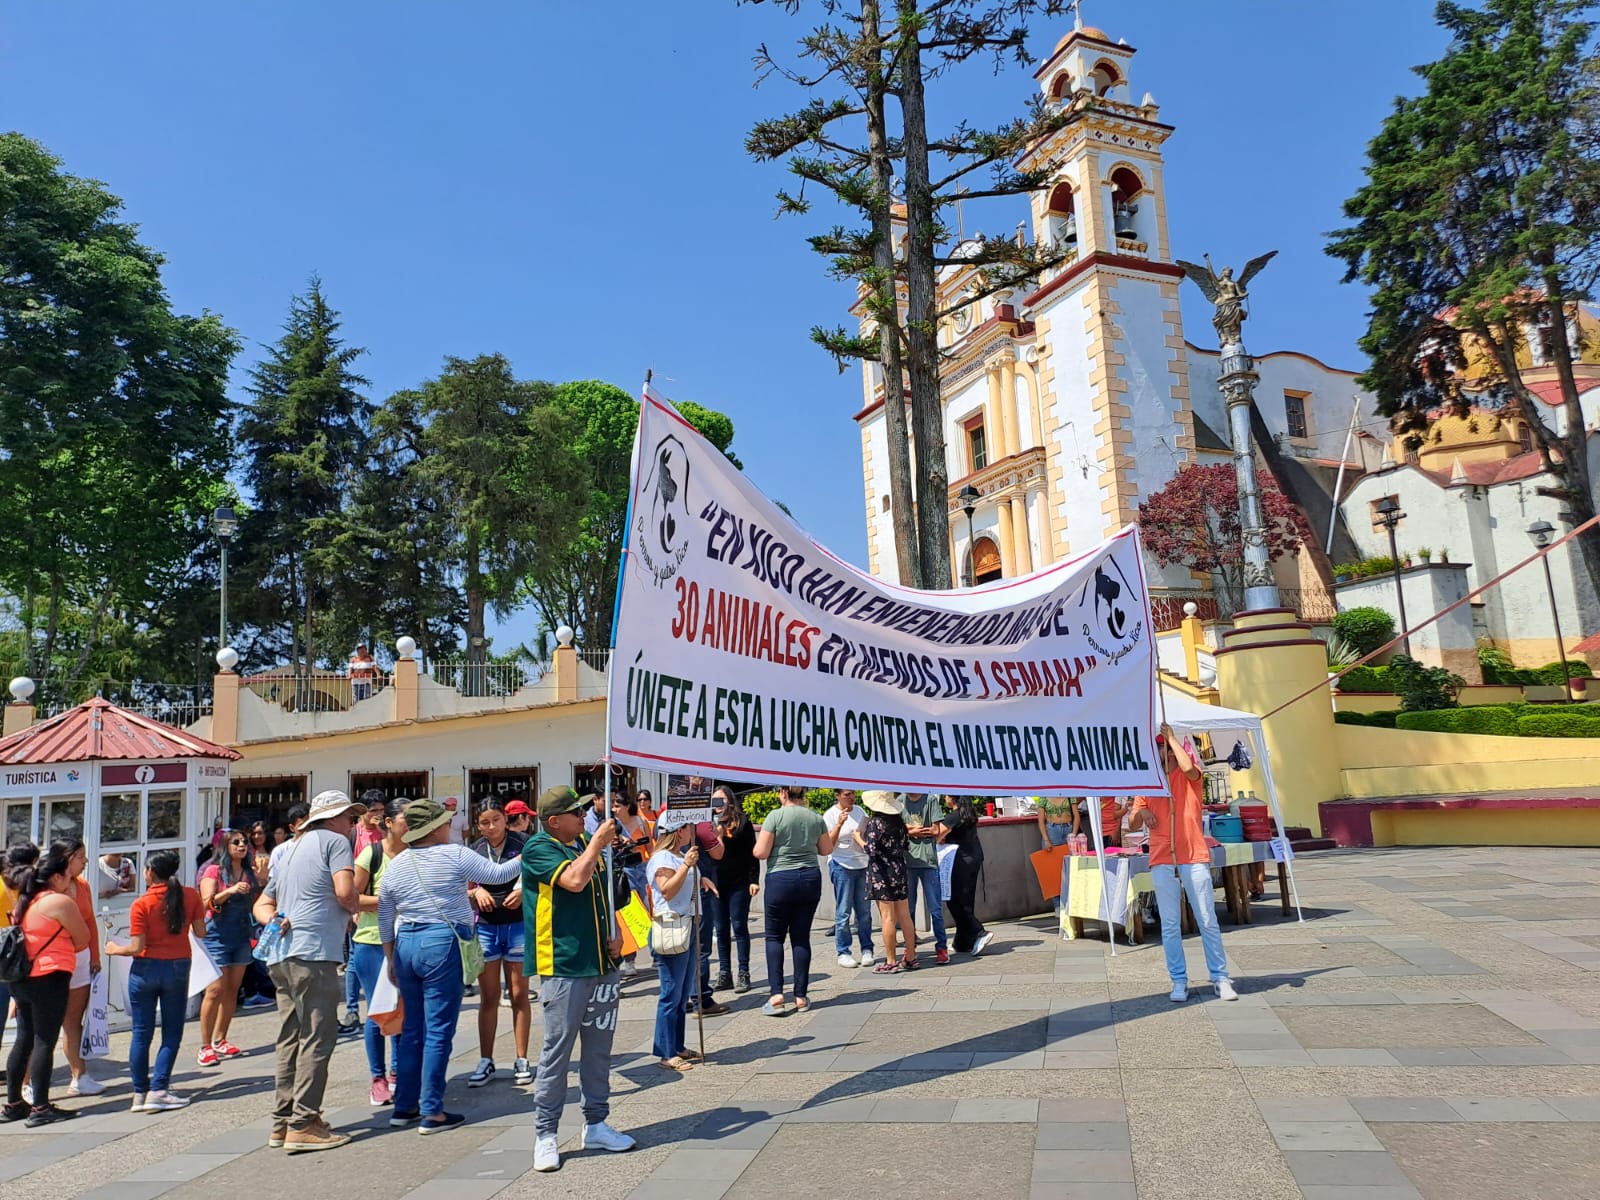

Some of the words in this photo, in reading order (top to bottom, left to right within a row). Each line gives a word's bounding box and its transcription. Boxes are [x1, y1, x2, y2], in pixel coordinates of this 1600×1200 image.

[671, 576, 699, 643] 30
[701, 588, 821, 670] ANIMALES
[817, 632, 857, 676] EN
[851, 643, 942, 698] MENOS
[938, 657, 972, 699] DE
[973, 660, 990, 700] 1
[742, 523, 806, 593] XICO
[800, 567, 859, 616] HAN
[848, 593, 1014, 645] ENVENENADO
[1039, 594, 1072, 637] DE
[626, 649, 693, 738] ÚNETE
[692, 684, 708, 741] A
[713, 687, 764, 749] ESTA
[770, 697, 841, 758] LUCHA
[845, 710, 926, 767] CONTRA
[925, 721, 955, 769] EL
[952, 723, 1063, 771] MALTRATO
[1068, 726, 1149, 770] ANIMAL
[5, 770, 57, 785] TURÍSTICA
